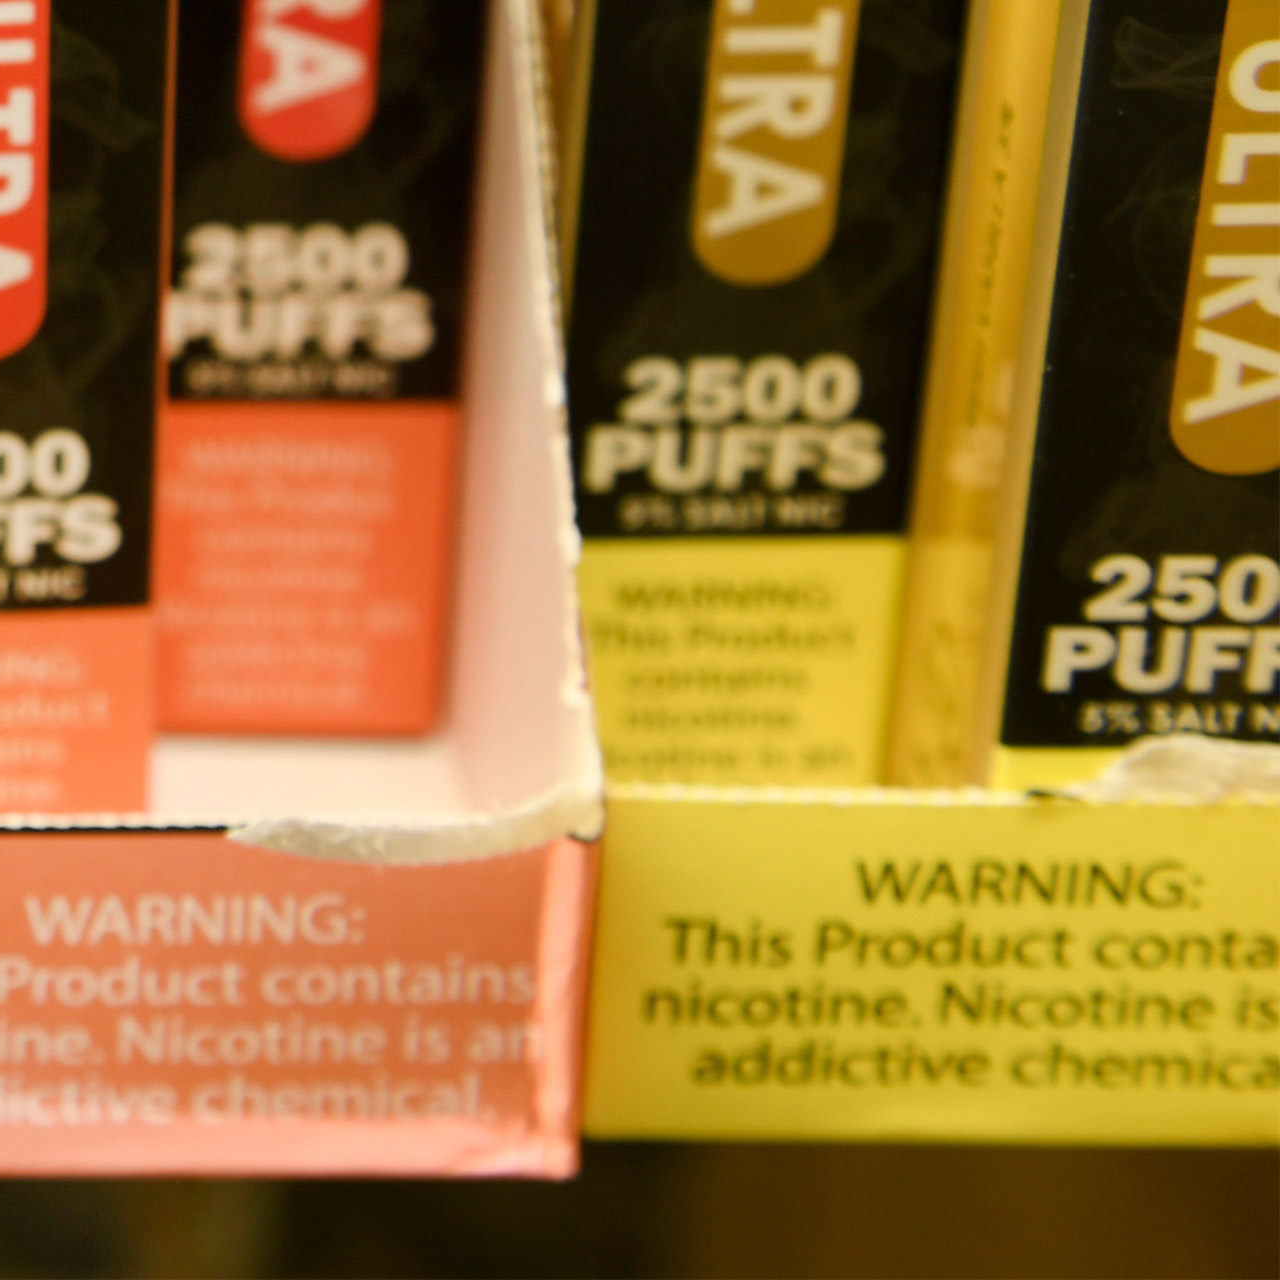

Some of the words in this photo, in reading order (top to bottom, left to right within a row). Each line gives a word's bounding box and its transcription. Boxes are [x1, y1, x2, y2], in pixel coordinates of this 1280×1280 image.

[184, 222, 410, 295] 2500
[167, 288, 434, 360] PUFFS
[617, 354, 862, 424] 2500
[583, 420, 887, 493] PUFFS
[855, 859, 1204, 911] WARNING:
[23, 893, 365, 946] WARNING:
[664, 918, 792, 969] This
[814, 918, 1071, 971] Product
[260, 951, 538, 1006] contains
[644, 981, 922, 1029] nicotine.
[939, 981, 1216, 1032] Nicotine
[116, 1016, 387, 1067] Nicotine
[403, 1013, 451, 1065] is
[467, 1020, 542, 1065] an
[690, 1042, 991, 1090] addictive
[189, 1070, 499, 1128] chemical.
